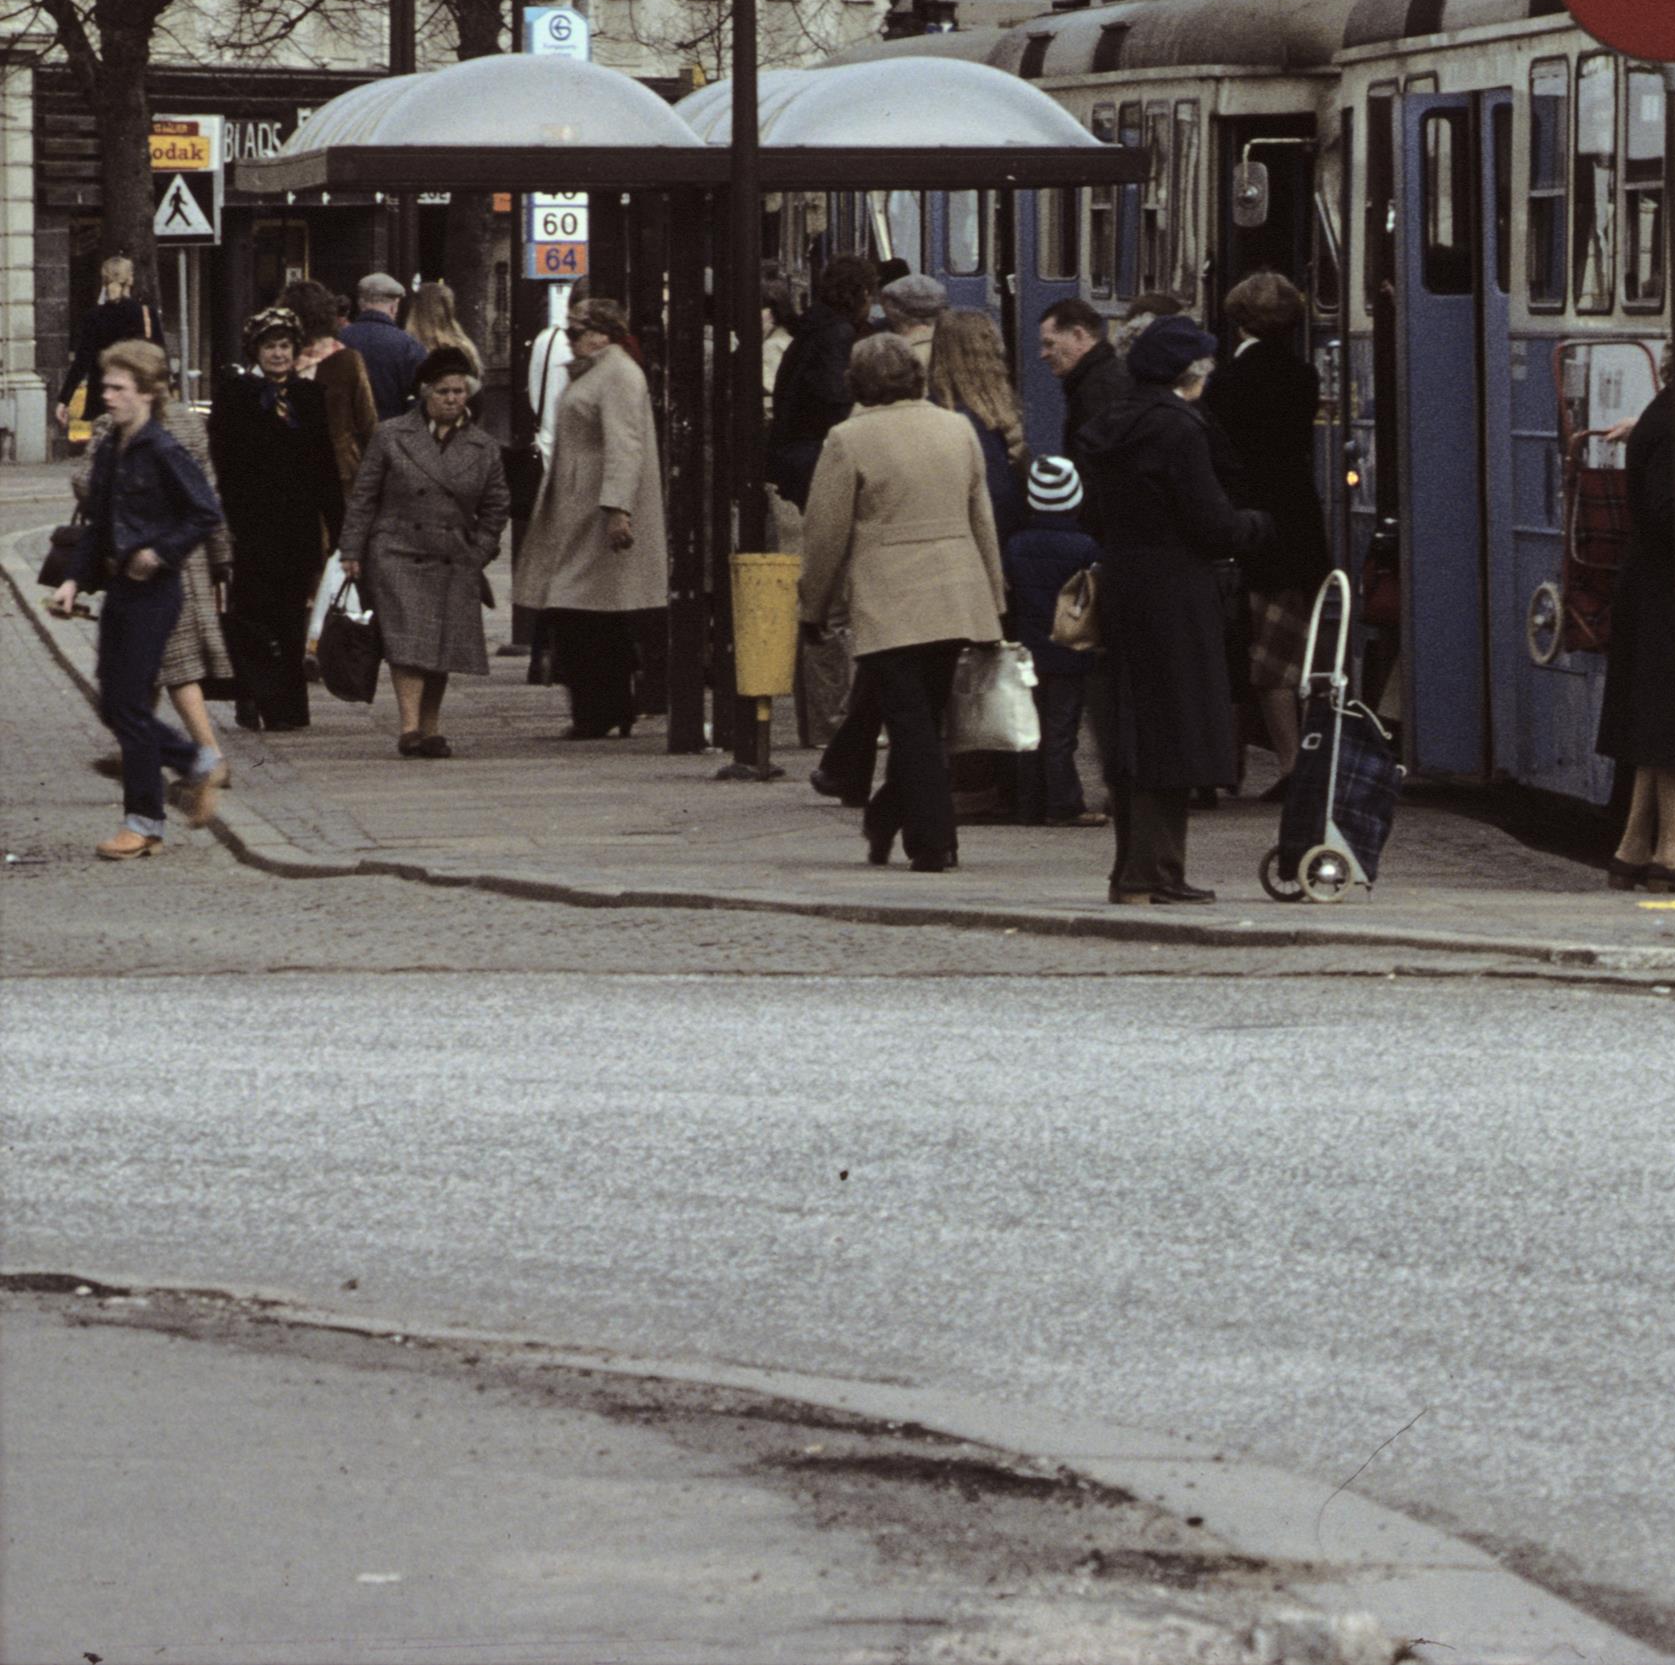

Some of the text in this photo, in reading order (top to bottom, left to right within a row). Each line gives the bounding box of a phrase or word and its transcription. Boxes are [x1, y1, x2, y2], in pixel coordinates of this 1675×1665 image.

[149, 142, 204, 162] odak
[542, 212, 578, 236] 60
[545, 248, 577, 272] 64
